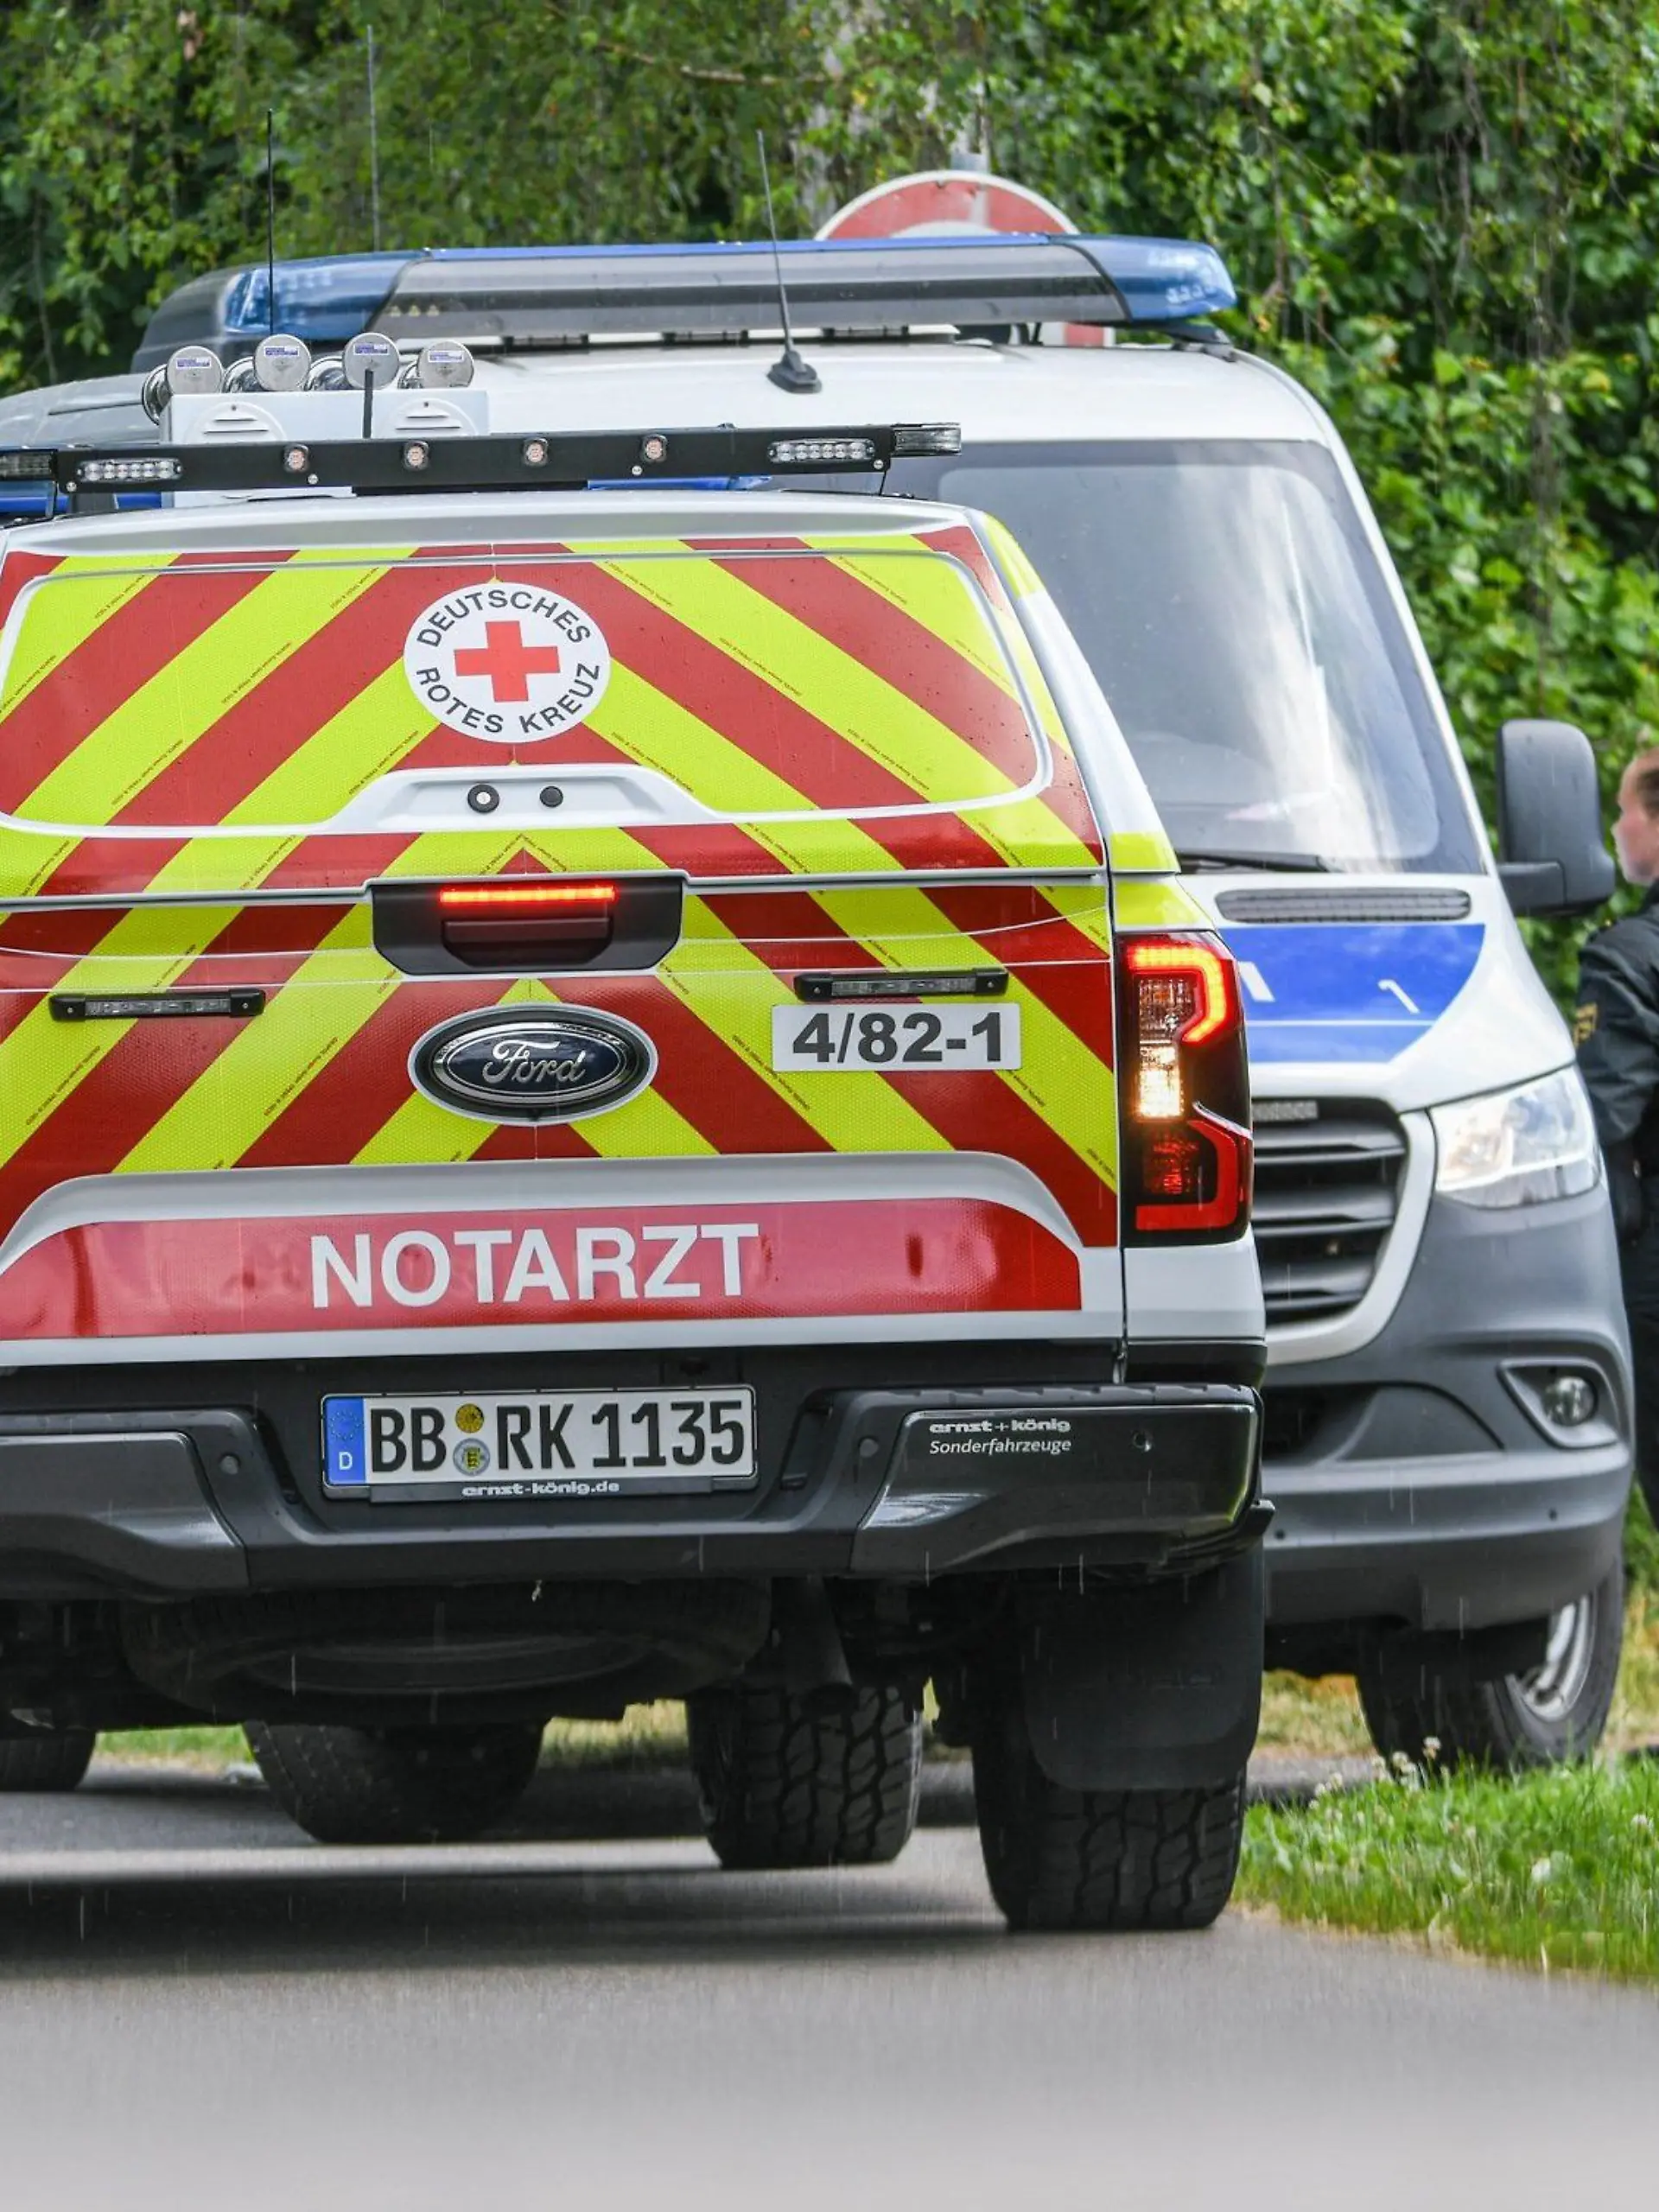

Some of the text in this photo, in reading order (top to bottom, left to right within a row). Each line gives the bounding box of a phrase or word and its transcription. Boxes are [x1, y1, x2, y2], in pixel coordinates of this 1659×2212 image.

[416, 589, 591, 647] DEUTSCHES
[416, 663, 600, 733] ROTES KREUZ
[482, 1039, 586, 1084] Ford
[791, 1011, 1002, 1065] 4/82-1
[310, 1223, 760, 1309] NOTARZT
[339, 1452, 353, 1470] D
[370, 1401, 745, 1472] BB RK 1135
[930, 1438, 1071, 1455] Sonderfahrzeuge
